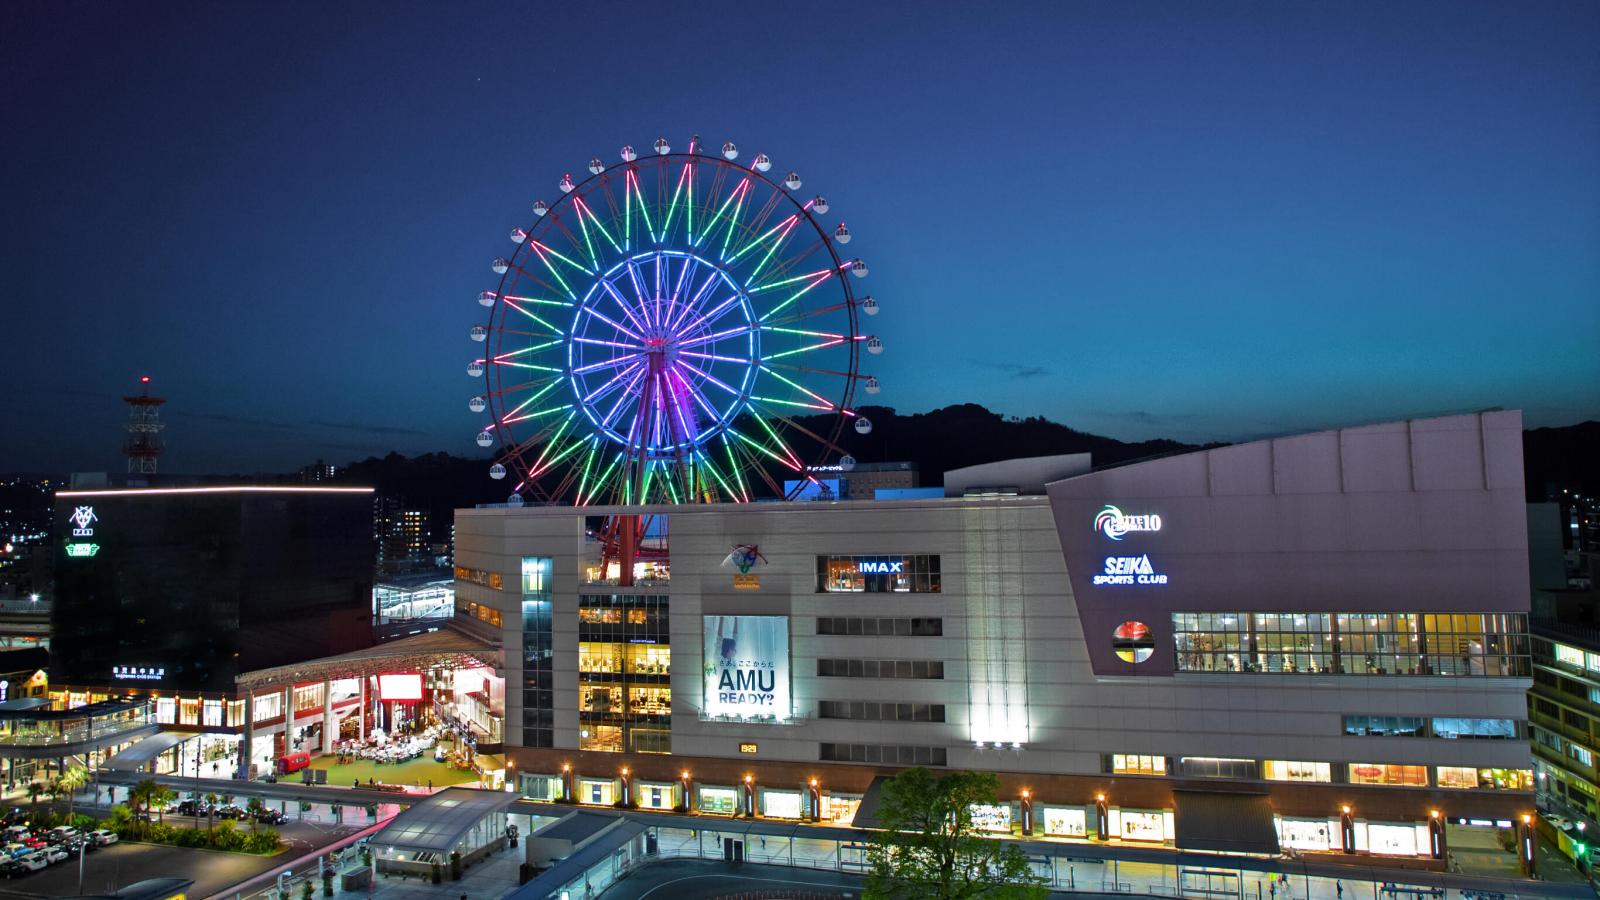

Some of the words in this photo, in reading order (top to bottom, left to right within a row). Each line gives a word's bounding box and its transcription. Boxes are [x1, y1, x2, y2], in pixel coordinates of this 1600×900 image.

[1143, 514, 1162, 531] 10
[859, 562, 901, 573] IMAX
[1104, 553, 1154, 575] SEIKA
[1093, 575, 1134, 585] SPORTS
[1137, 575, 1168, 584] CLUB
[718, 669, 775, 692] AMU
[719, 692, 774, 706] READY?
